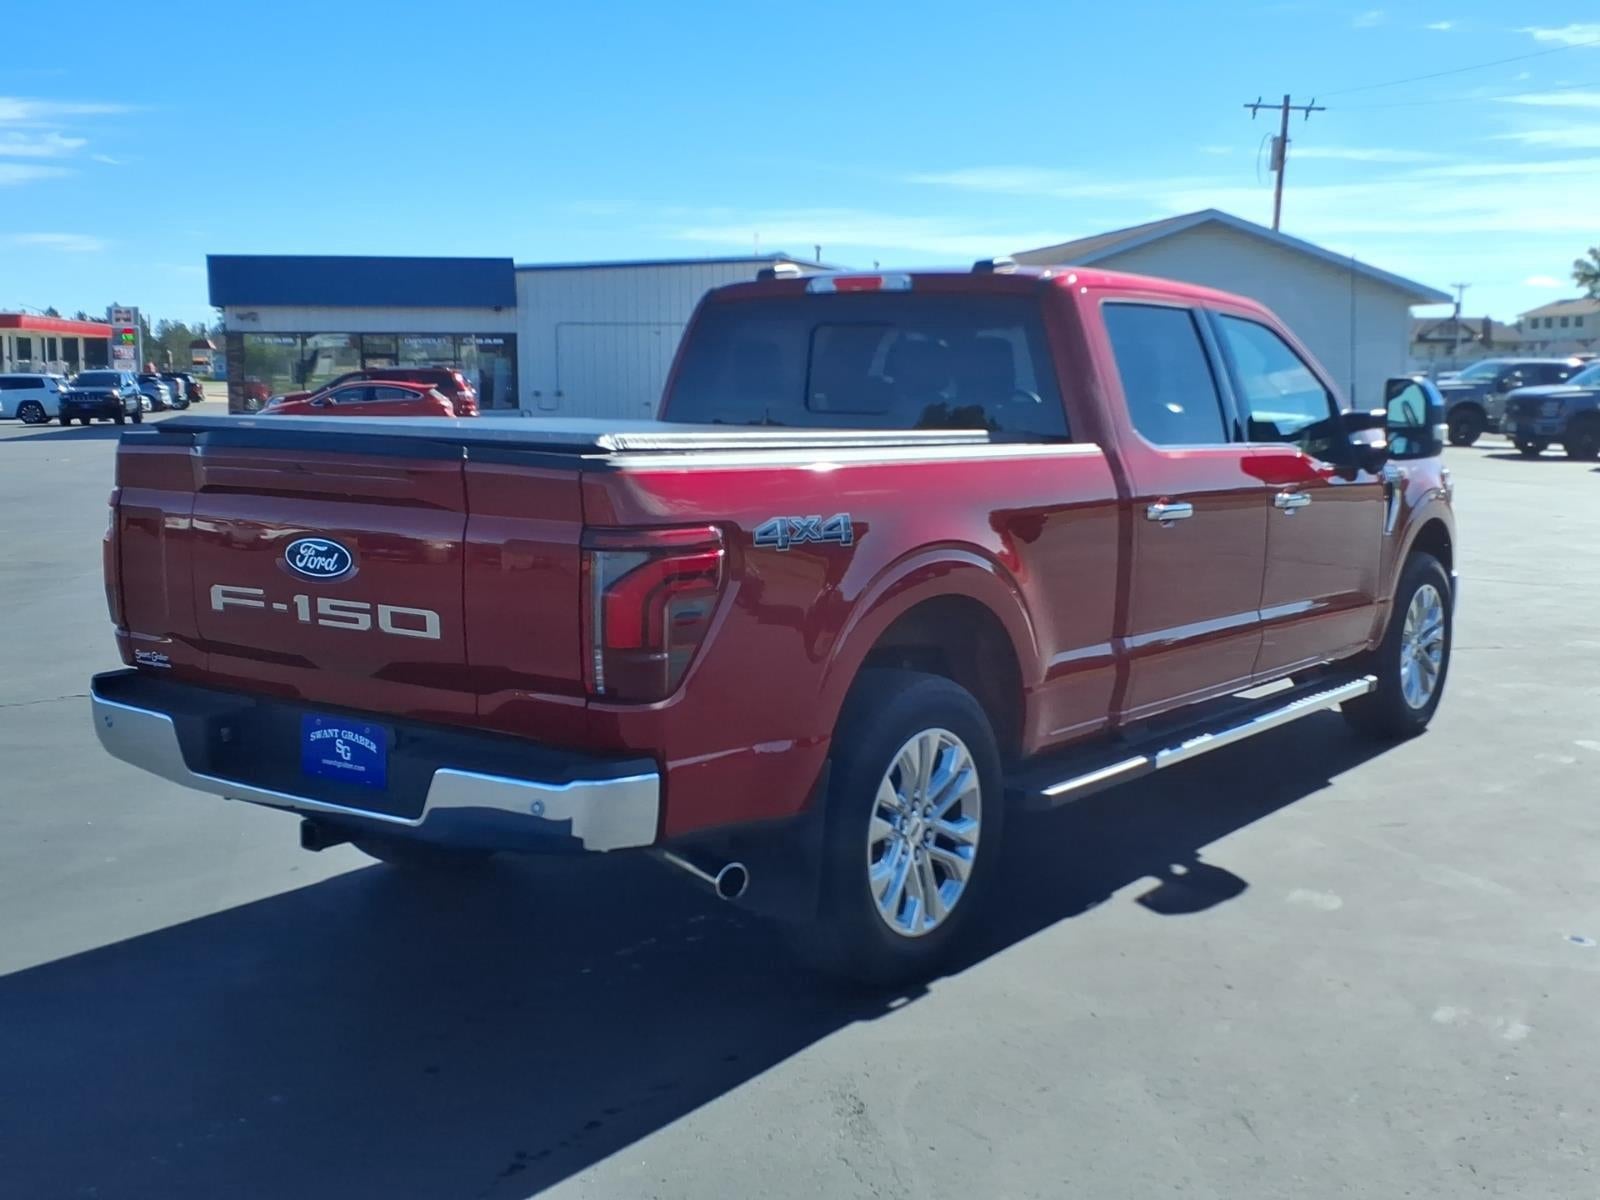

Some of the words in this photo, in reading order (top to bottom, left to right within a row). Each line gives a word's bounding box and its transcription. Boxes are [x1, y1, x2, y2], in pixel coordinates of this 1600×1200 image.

[295, 542, 339, 572] Ford
[210, 584, 441, 640] F-150
[309, 728, 340, 742] SWANT
[341, 729, 377, 754] GRABER
